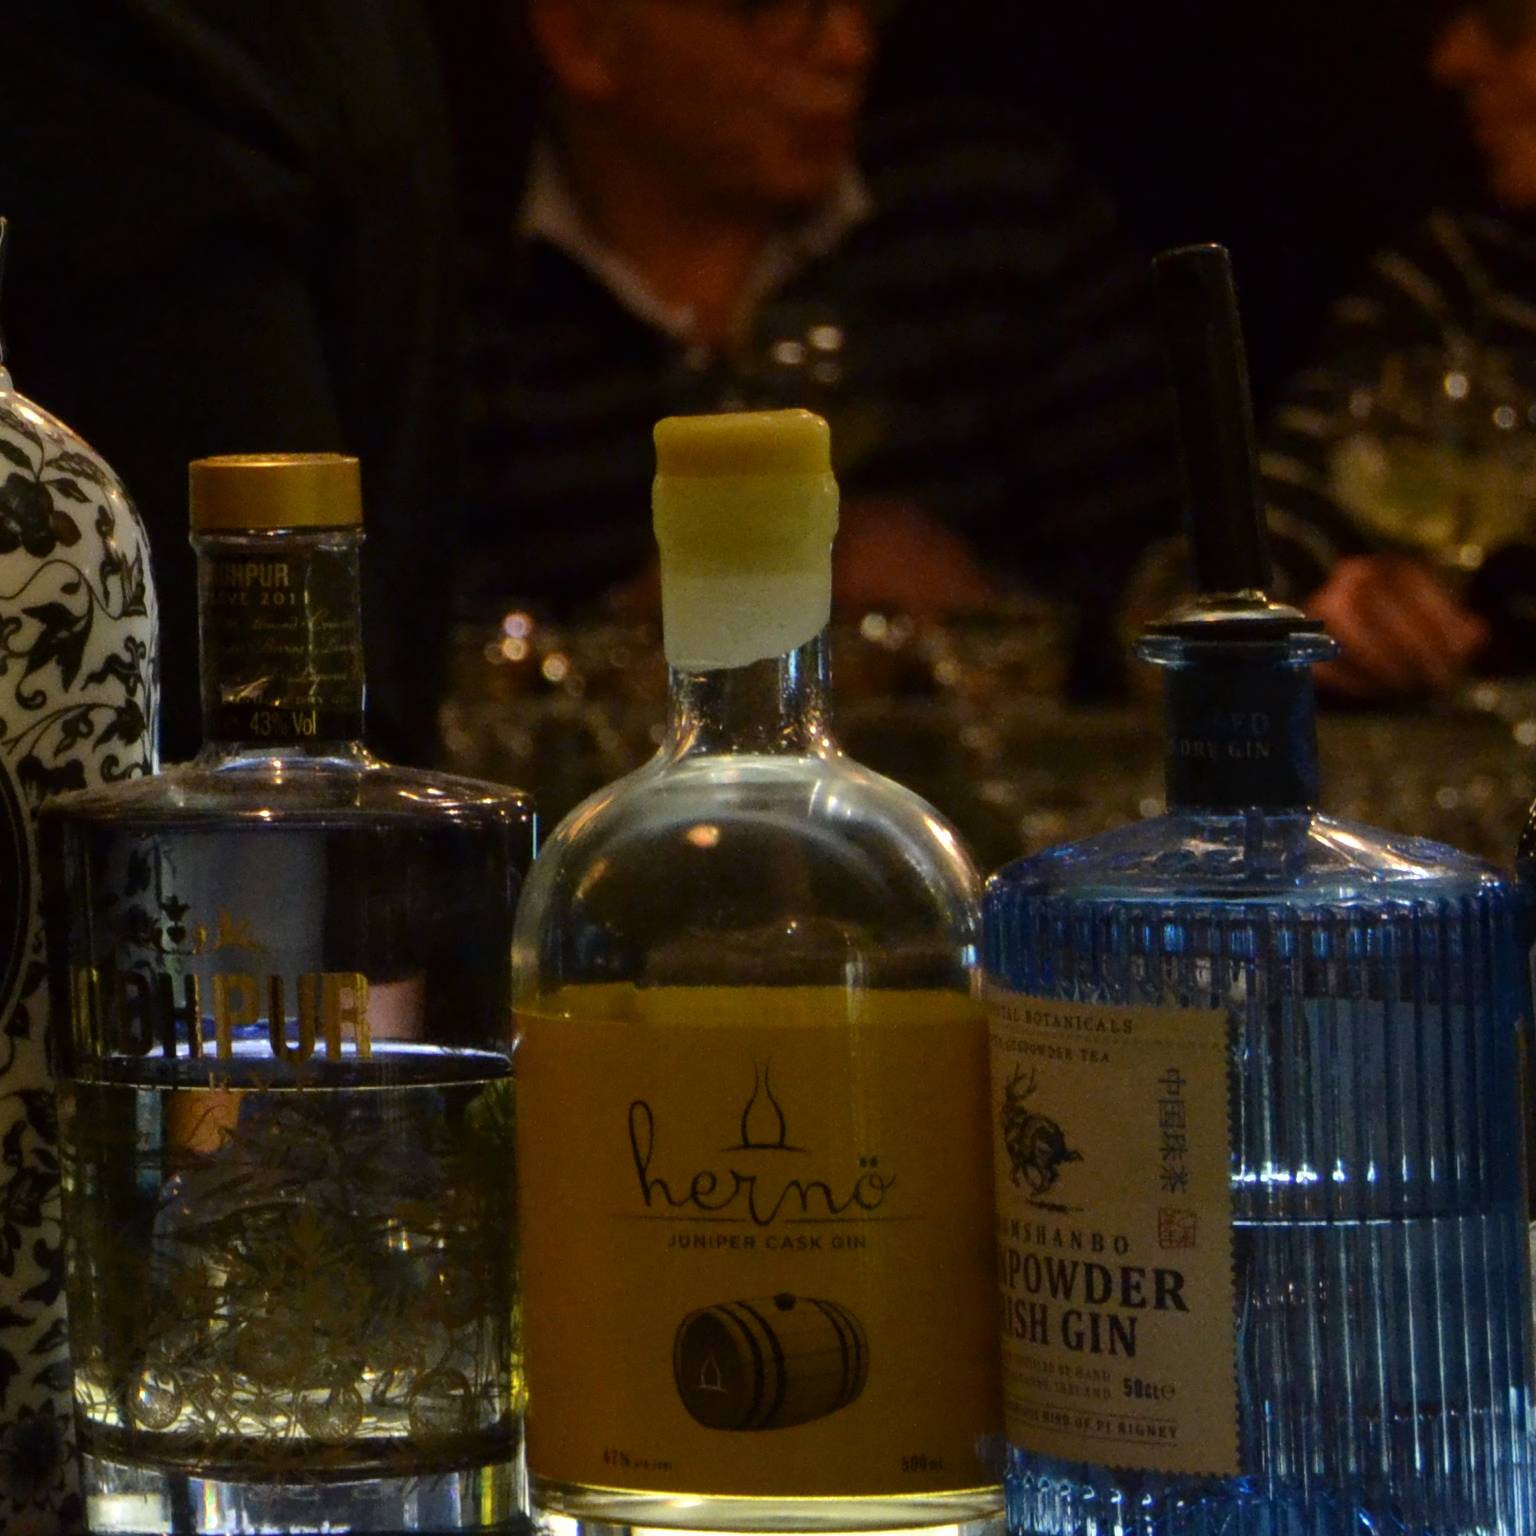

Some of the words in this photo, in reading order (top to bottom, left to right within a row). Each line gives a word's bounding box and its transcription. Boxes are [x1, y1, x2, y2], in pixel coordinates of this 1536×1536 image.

[291, 710, 318, 736] Vol
[1228, 740, 1271, 760] GIN
[1025, 1010, 1133, 1035] BOTANICALS
[1080, 1048, 1110, 1063] TEA
[628, 1100, 897, 1227] hernö
[667, 1233, 756, 1249] JUNIPER
[765, 1234, 822, 1250] CASK
[831, 1234, 867, 1250] GIN
[1061, 1309, 1138, 1357] GIN
[1118, 1421, 1179, 1440] RIGNEY
